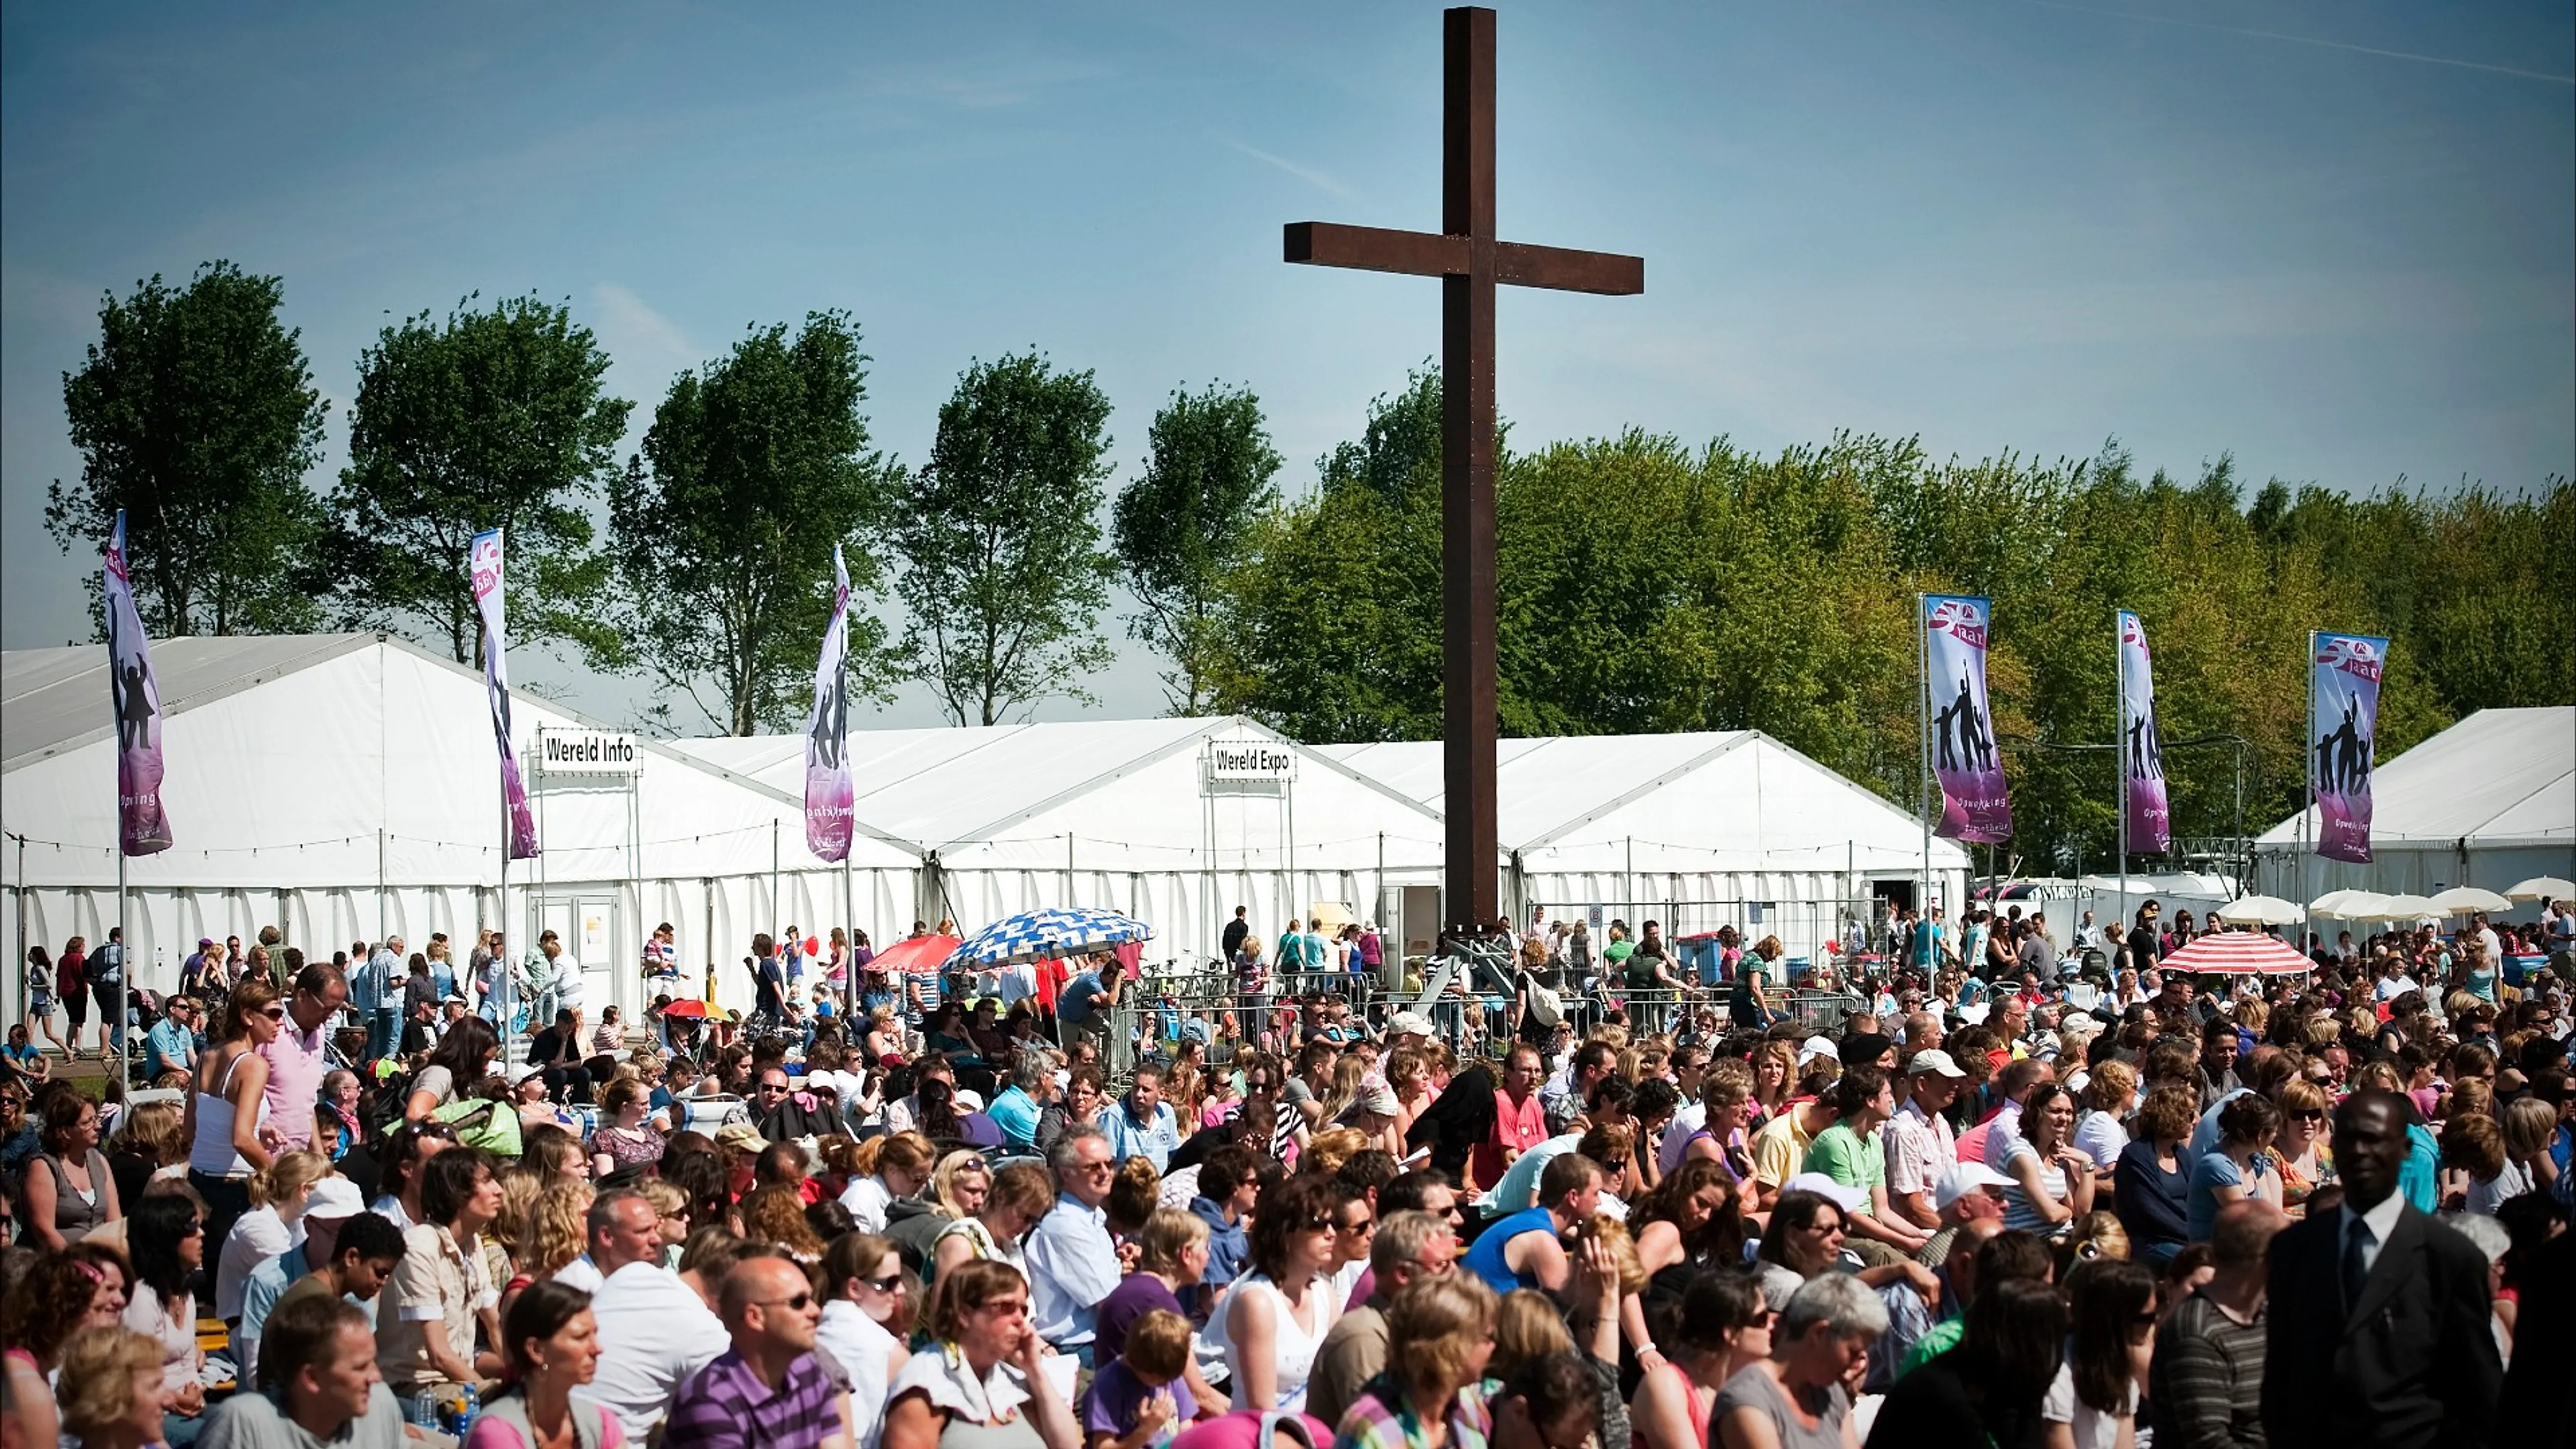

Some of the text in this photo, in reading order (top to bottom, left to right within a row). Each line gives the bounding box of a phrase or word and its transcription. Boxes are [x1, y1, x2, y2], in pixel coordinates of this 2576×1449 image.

[547, 737, 633, 761] Wereld Info
[1216, 749, 1289, 775] Wereld Expo
